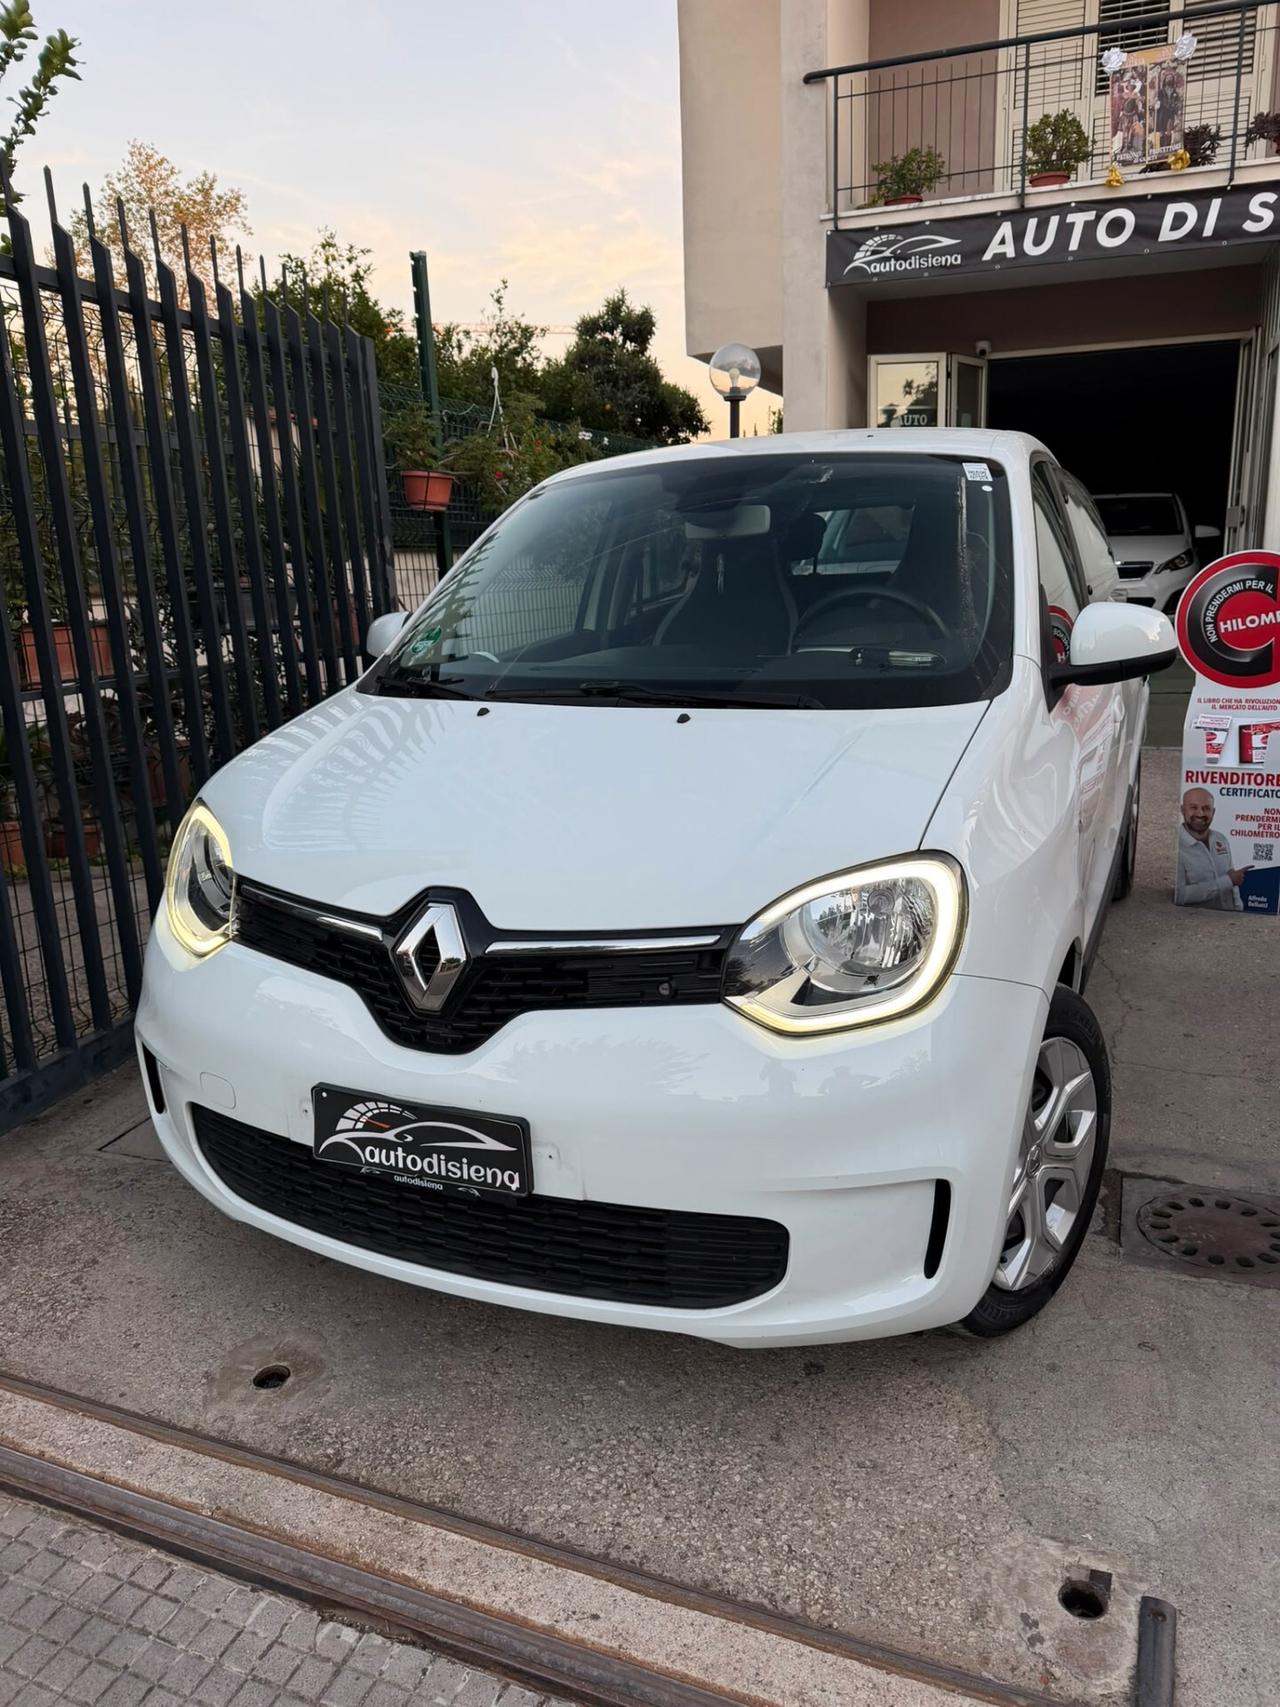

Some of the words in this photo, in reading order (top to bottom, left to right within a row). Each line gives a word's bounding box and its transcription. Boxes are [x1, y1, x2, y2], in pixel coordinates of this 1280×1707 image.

[981, 207, 1136, 261] AUTO
[1157, 198, 1223, 242] DI
[1241, 191, 1279, 233] S
[870, 253, 962, 274] autodisiena
[1245, 579, 1265, 590] PER
[1265, 583, 1274, 594] IL
[1205, 581, 1244, 622] PRENDERMI
[1205, 624, 1218, 643] NON
[1235, 814, 1280, 823] PRENDERMI
[364, 1145, 520, 1191] autodisiena
[393, 1174, 444, 1191] autodisiena
